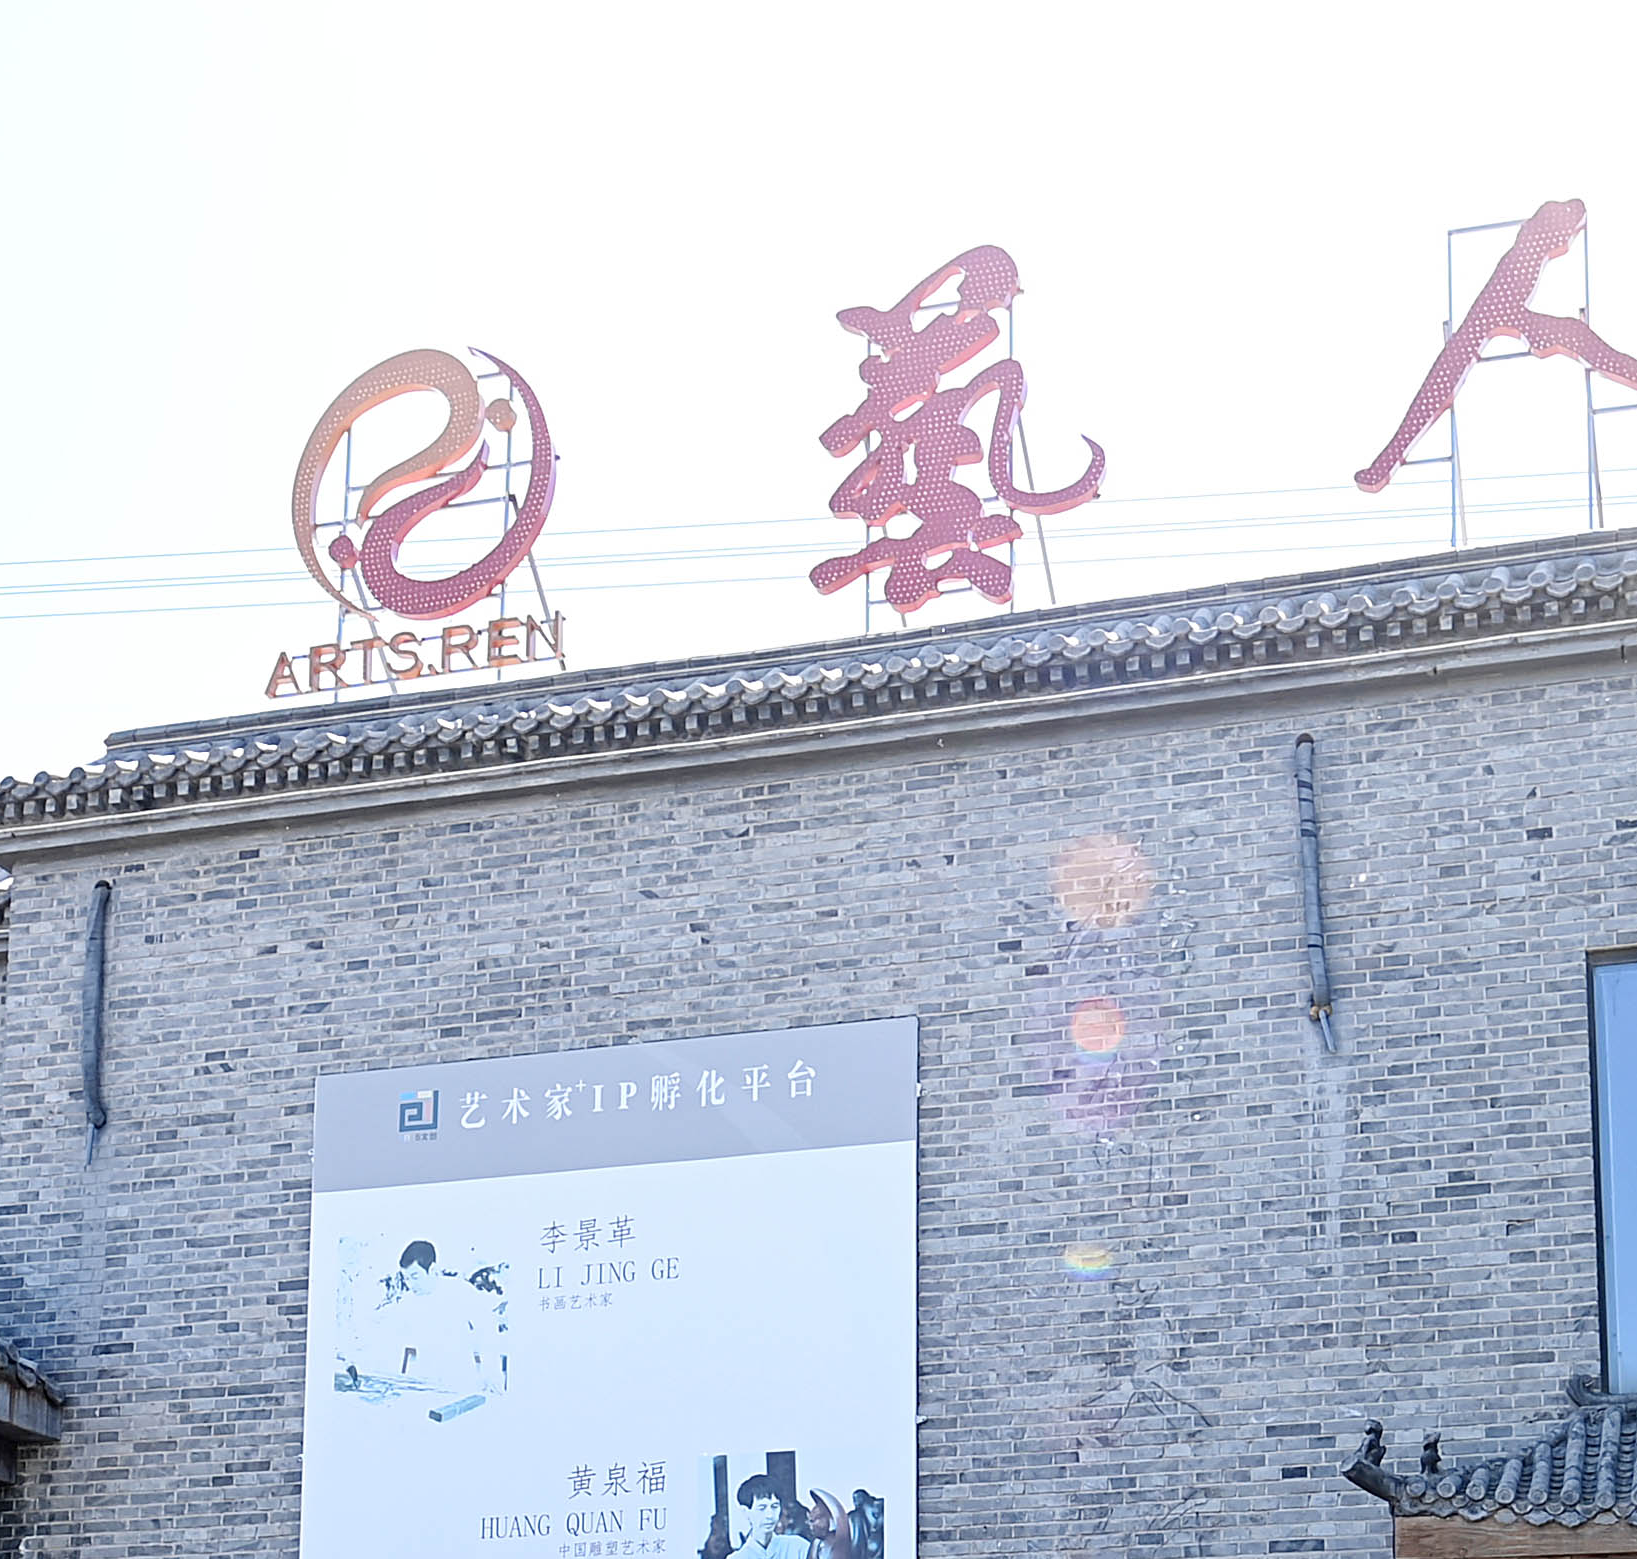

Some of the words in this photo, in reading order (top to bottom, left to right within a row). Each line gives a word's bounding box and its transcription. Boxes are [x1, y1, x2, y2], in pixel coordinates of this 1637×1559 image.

[265, 610, 566, 699] ARTS.REN
[539, 1214, 637, 1254] 李景革
[538, 1266, 564, 1289] LI
[580, 1260, 636, 1286] JING
[651, 1256, 680, 1281] GE
[567, 1460, 666, 1500] 黄泉福
[481, 1513, 551, 1540] HUANG
[566, 1510, 623, 1537] QUAN
[639, 1507, 667, 1531] FU
